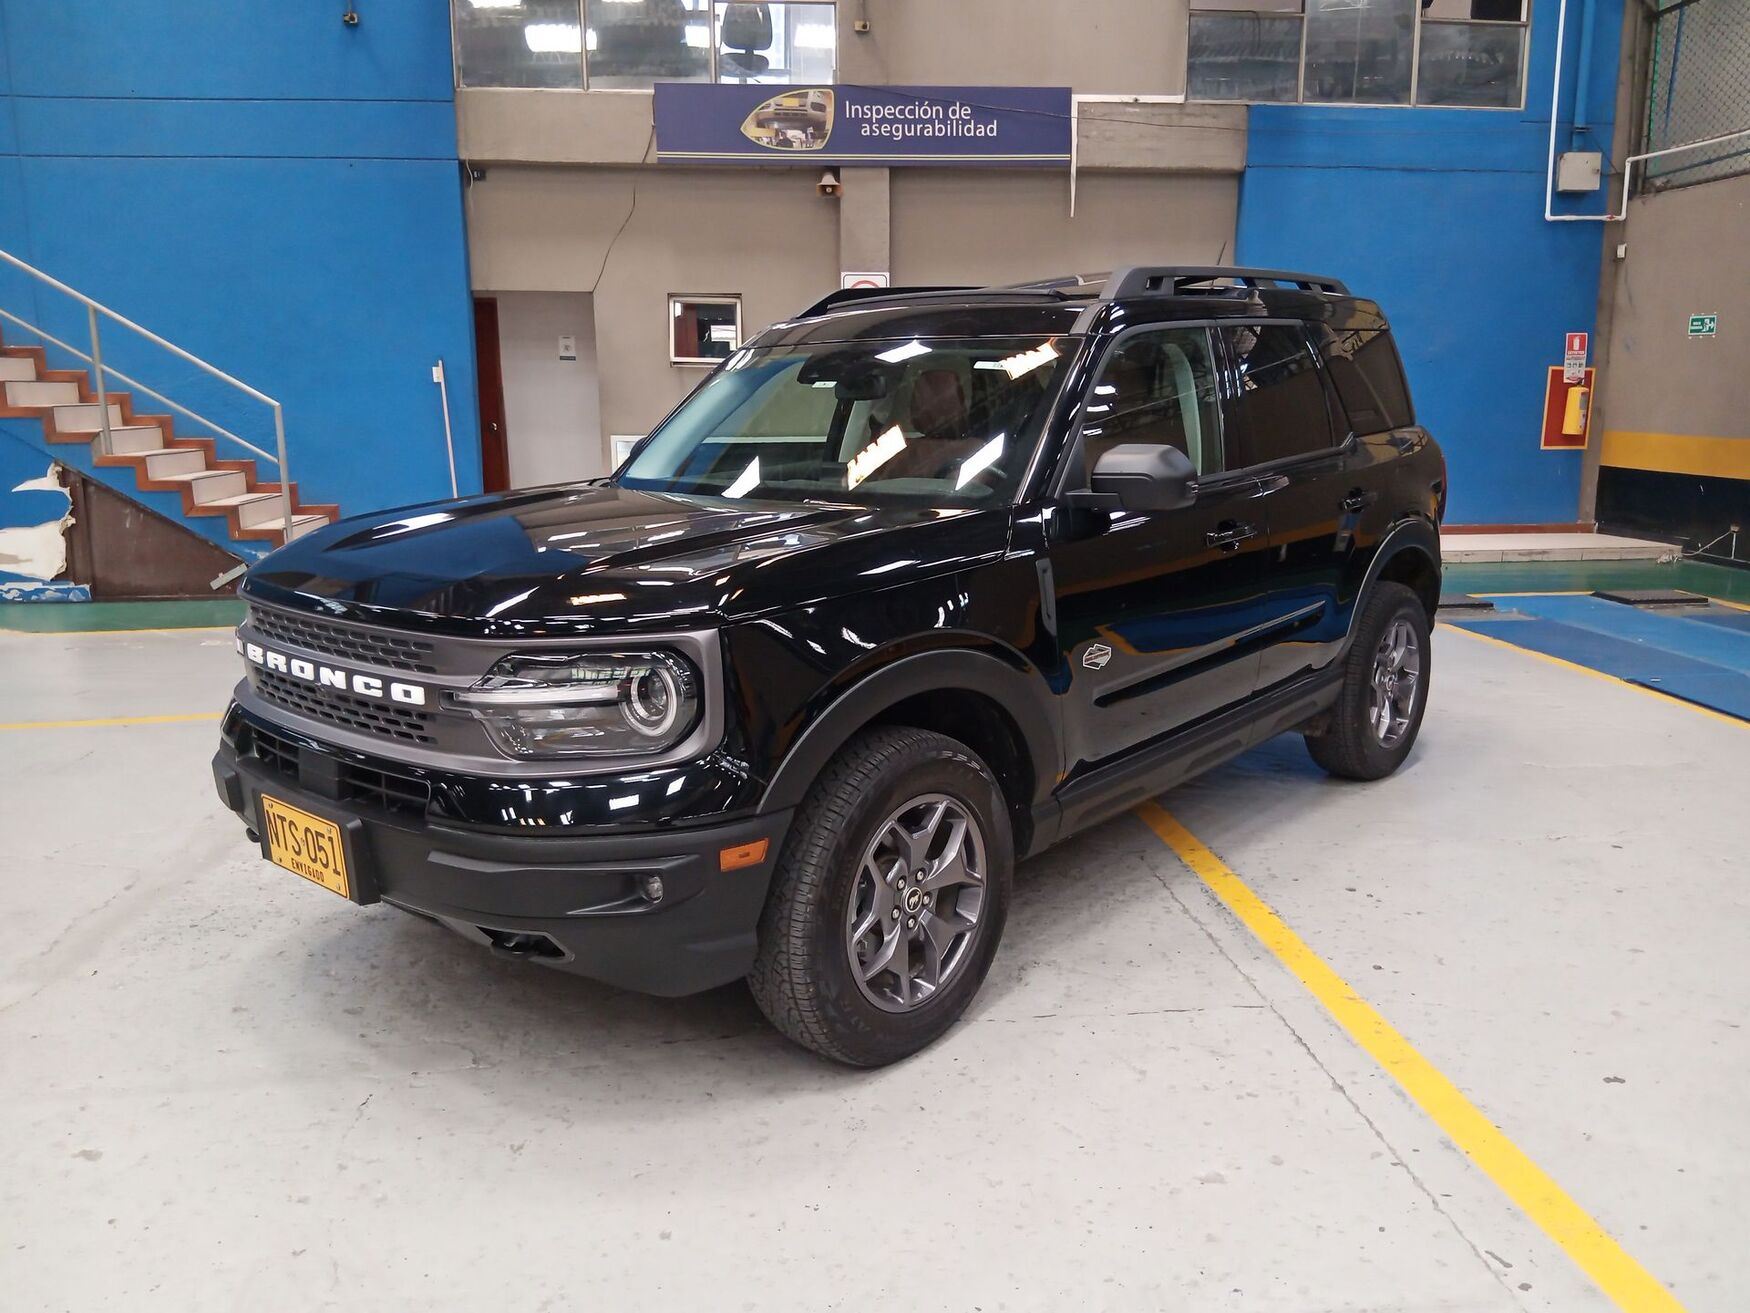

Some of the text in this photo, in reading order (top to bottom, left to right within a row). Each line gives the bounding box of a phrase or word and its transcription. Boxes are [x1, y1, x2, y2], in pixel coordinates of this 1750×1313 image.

[845, 100, 972, 123] Inspección de
[861, 119, 998, 140] asegurabilidad
[246, 642, 426, 706] BRONCO
